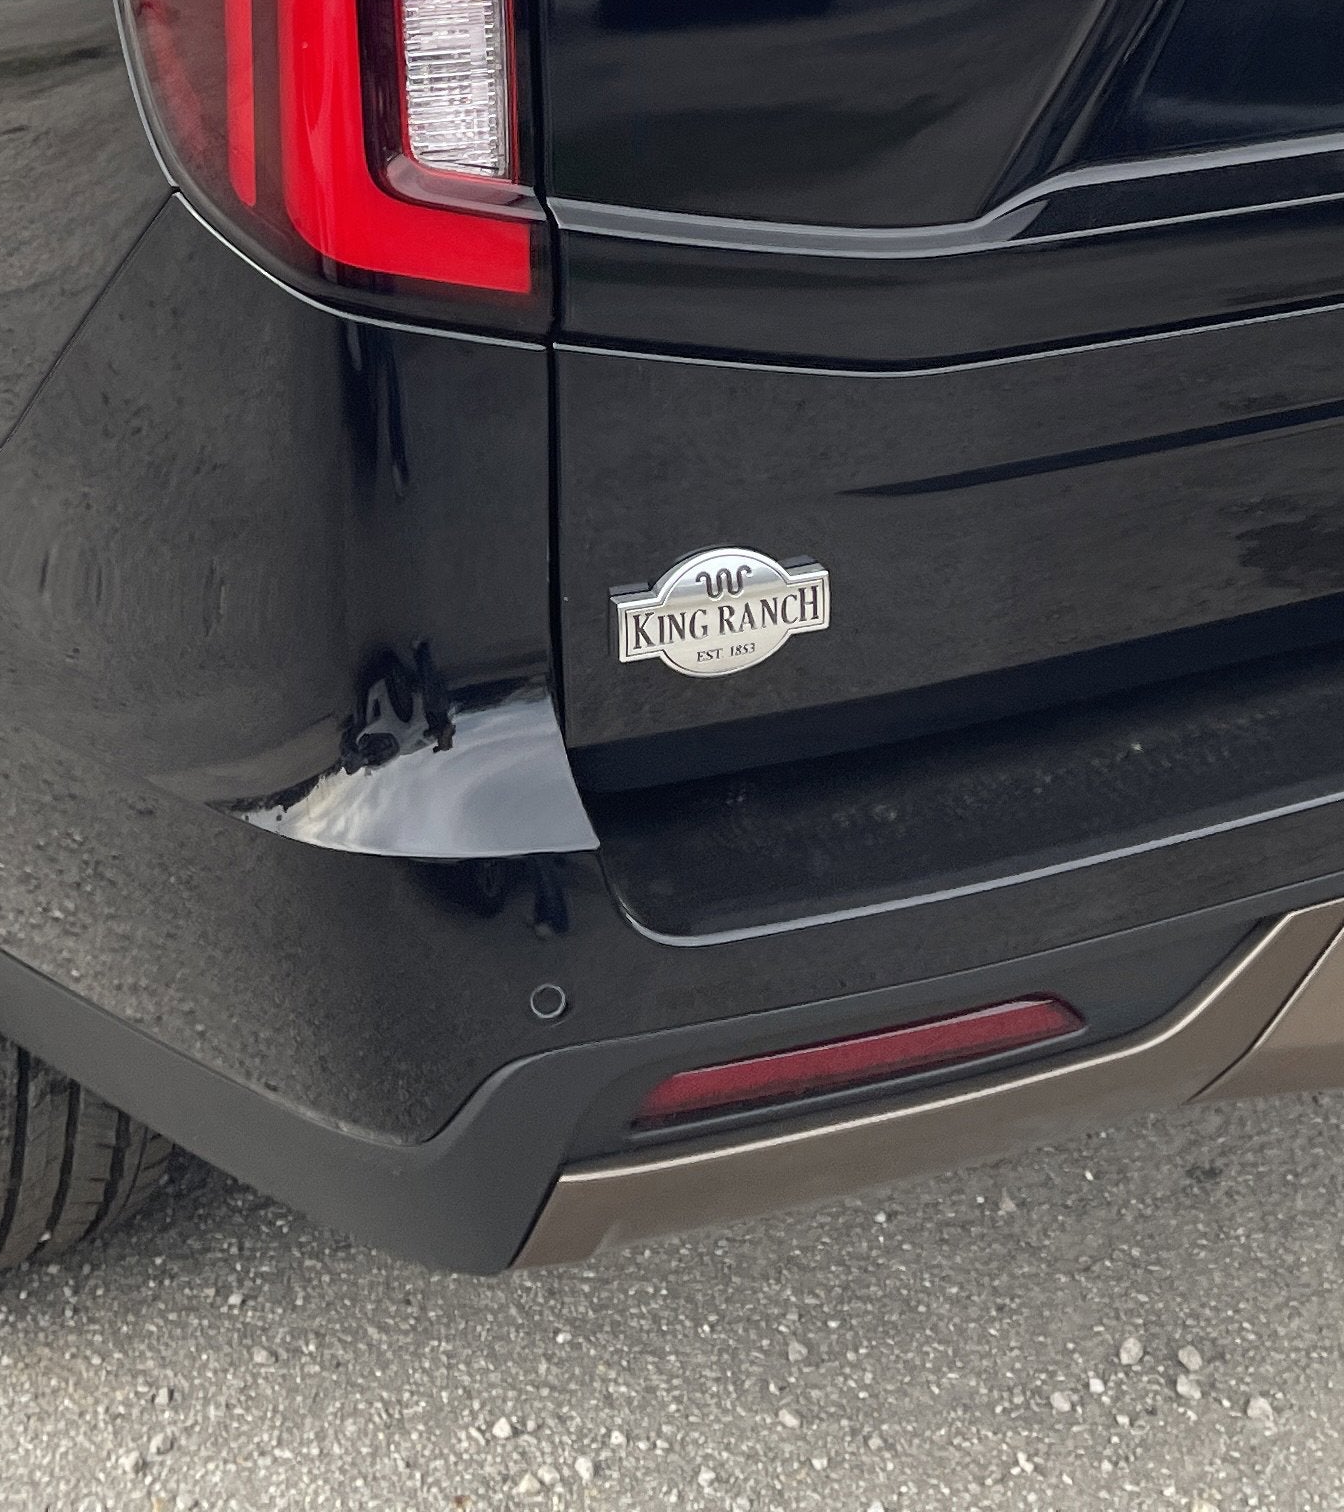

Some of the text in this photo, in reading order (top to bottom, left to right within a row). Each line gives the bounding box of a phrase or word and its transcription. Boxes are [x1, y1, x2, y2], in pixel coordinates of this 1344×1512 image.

[633, 585, 819, 650] KING RANCH
[696, 642, 756, 662] EST 1853
